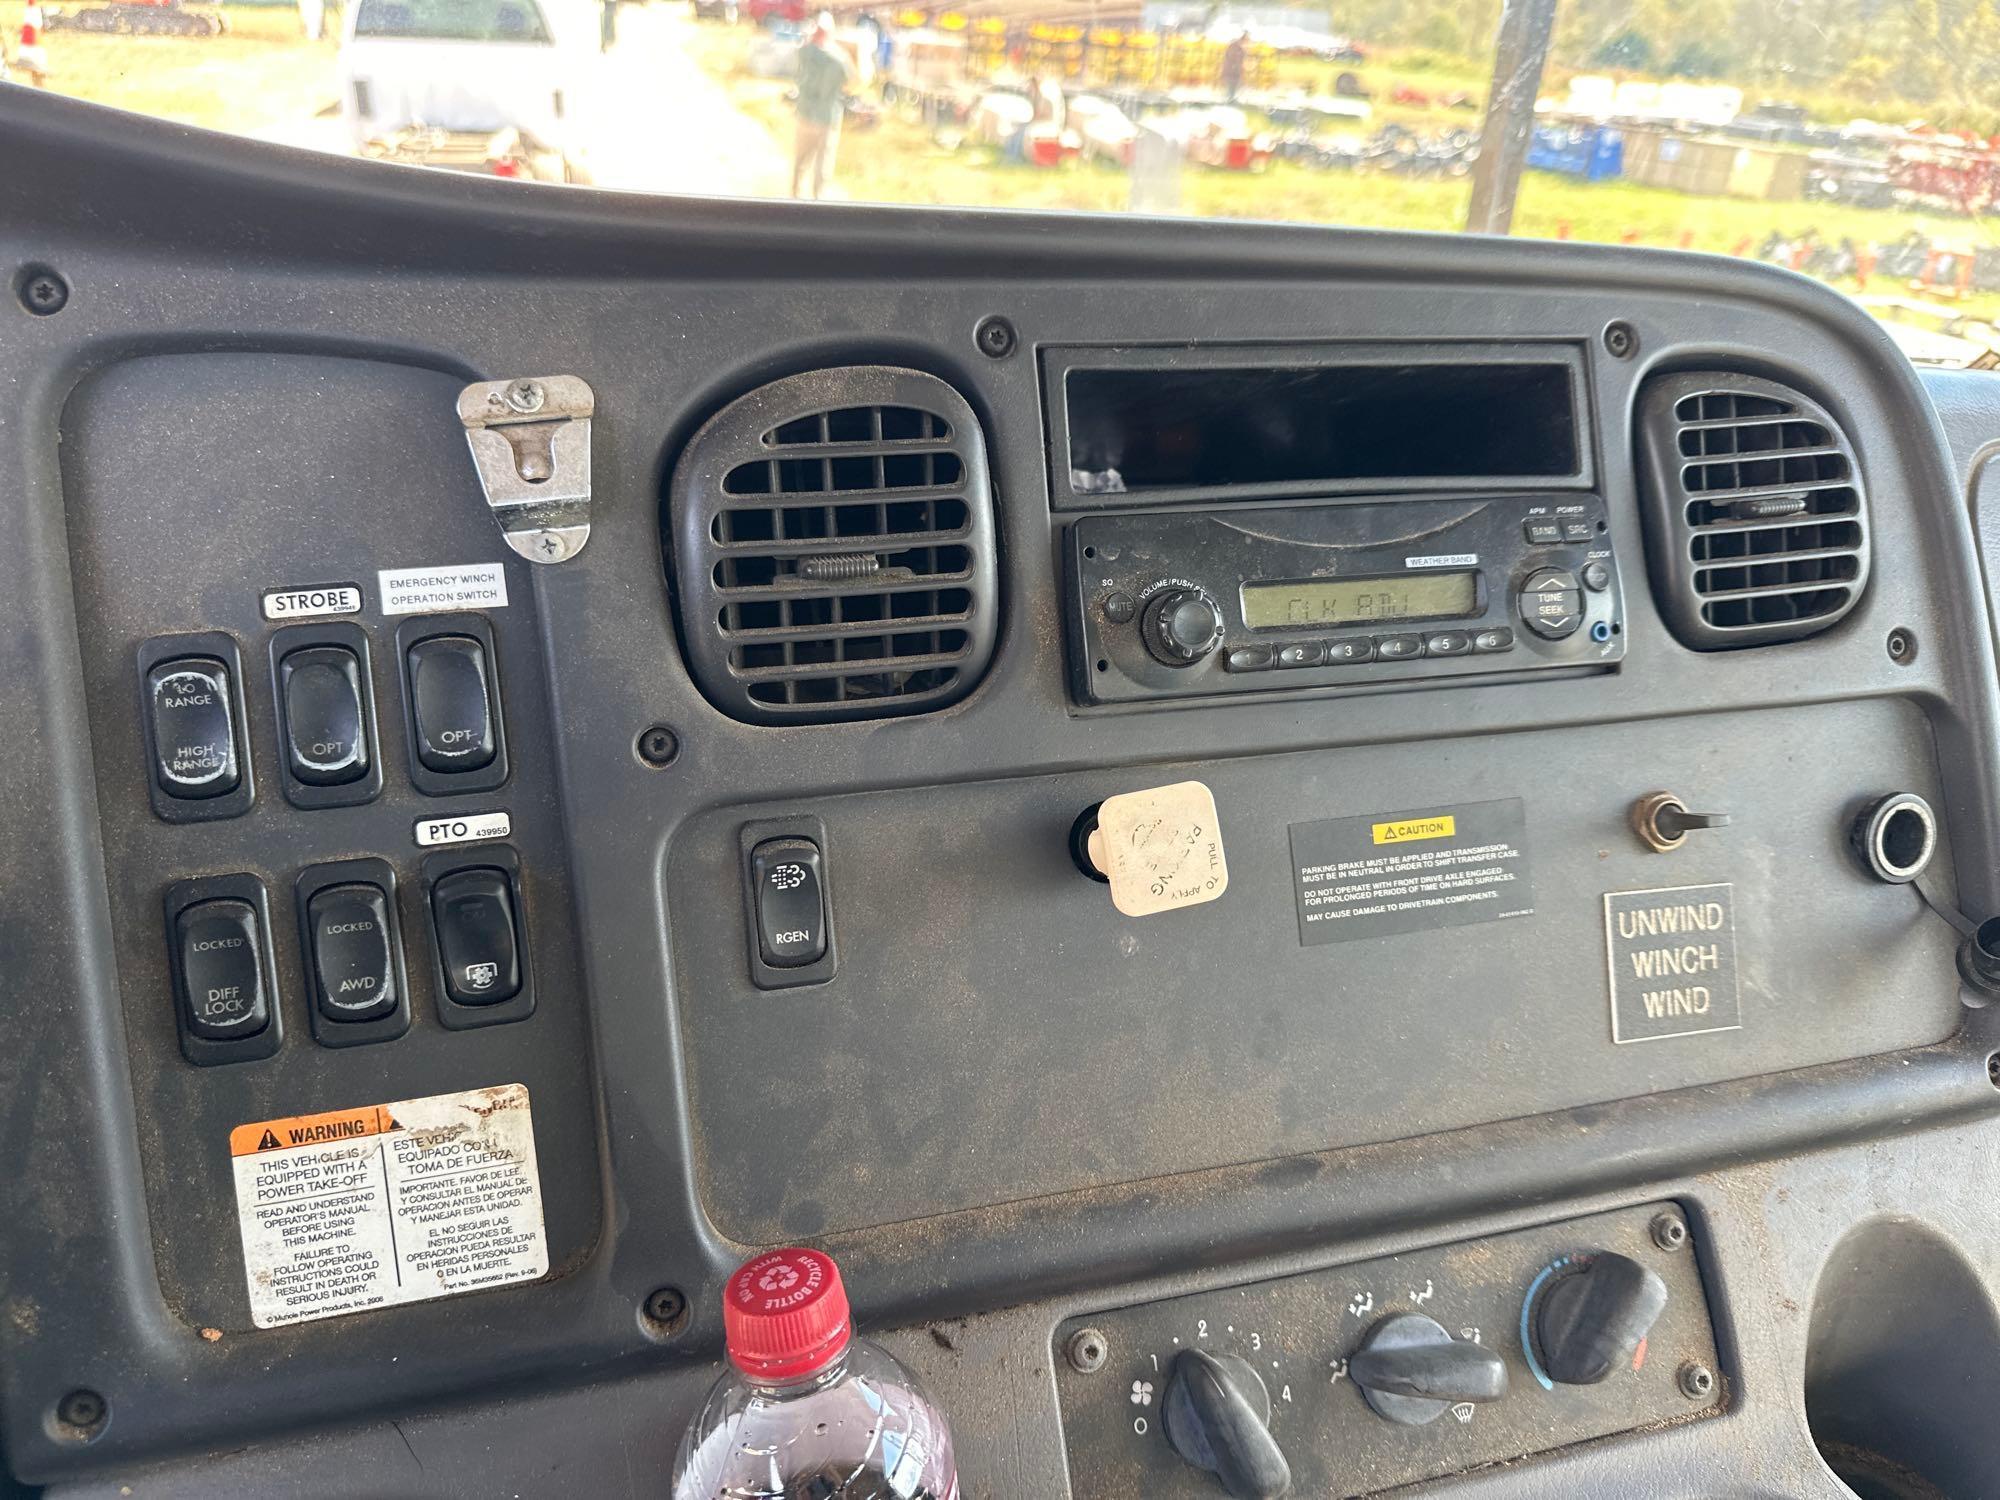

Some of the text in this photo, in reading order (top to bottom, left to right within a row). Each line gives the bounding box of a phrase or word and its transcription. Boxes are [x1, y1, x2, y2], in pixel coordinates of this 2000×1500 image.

[1532, 527, 1556, 535] BAND
[1568, 525, 1588, 534] SRC
[1410, 555, 1473, 566] WEATHER BAND
[390, 574, 495, 589] EMERGENCY WINCH
[275, 591, 349, 612] STROBE
[391, 589, 497, 605] OPERATION SWITCH
[1109, 601, 1133, 611] MUTE
[1538, 593, 1563, 603] TUNE
[1539, 605, 1565, 615] SEEK
[1442, 638, 1449, 649] 5
[1489, 636, 1496, 646] 6
[1296, 650, 1303, 660] 2
[1345, 646, 1352, 657] 3
[165, 695, 212, 708] RANGE
[441, 729, 473, 743] OPT
[178, 745, 214, 757] HIGH
[312, 741, 343, 756] OPT
[173, 758, 219, 770] RANGE
[429, 822, 508, 840] PTO 439950
[1398, 822, 1444, 836] CAUTION
[1302, 865, 1336, 875] PARKING
[1338, 861, 1365, 870] BRAKE
[1367, 858, 1387, 867] MUST
[1402, 852, 1434, 862] APPLIED
[1453, 844, 1508, 856] TRANSMISSION
[1303, 874, 1324, 883] MUST
[1326, 872, 1337, 880] BE
[1348, 867, 1384, 877] NEUTRAL
[1395, 861, 1422, 871] ORDER
[1435, 857, 1456, 866] SHIFT
[1458, 853, 1497, 863] TRANSFER
[1305, 898, 1321, 906] FOR
[1323, 892, 1371, 903] PROLONGED
[1374, 887, 1407, 897] PERIODS
[1420, 883, 1438, 891] TIME
[1452, 878, 1473, 887] HARD
[1318, 888, 1333, 896] NOT
[1335, 884, 1371, 894] OPERATE
[1373, 881, 1391, 889] WITH
[1394, 877, 1419, 887] FRONT
[1421, 875, 1443, 884] DRIVE
[1445, 872, 1465, 880] AXLE
[1325, 910, 1351, 919] CAUSE
[1353, 905, 1385, 915] DAMAGE
[1399, 898, 1445, 910] DRIVETRAIN
[1446, 890, 1498, 903] COMPONENTS.
[327, 921, 373, 935] LOCKED
[1619, 903, 1724, 939] UNWIND
[193, 938, 244, 952] LOCKED
[776, 930, 809, 945] RGEN
[1631, 944, 1719, 979] WINCH
[339, 976, 375, 992] AWD
[208, 986, 240, 1002] DIFF
[1642, 986, 1711, 1019] WIND
[205, 999, 244, 1016] LOCK
[289, 1120, 365, 1144] WARNING
[394, 1137, 424, 1151] ESTE
[260, 1148, 359, 1173] THIS VEHICLE IS
[398, 1145, 460, 1163] EQUIPADO
[408, 1150, 513, 1175] TOMA DE FUERZA
[257, 1160, 367, 1187] EQUIPPED WITH A
[460, 1169, 502, 1185] FAVOR DE
[258, 1173, 367, 1200] POWER TAKE-OFF
[400, 1196, 407, 1205] Y
[410, 1189, 462, 1204] CONSULTAR
[464, 1186, 475, 1195] EL
[477, 1179, 514, 1192] MANUAL
[452, 1196, 480, 1207] ANTES
[483, 1192, 495, 1201] DE
[497, 1186, 533, 1199] OPERAR
[257, 1193, 375, 1219] READ AND UNDERSTAND
[410, 1199, 522, 1225] Y MANEJAR ESTA UNIDAD.
[264, 1204, 370, 1229] OPERATOR'S MANUAL
[282, 1217, 355, 1236] BEFORE USING
[430, 1216, 509, 1237] EL NO SEGUIR LAS
[284, 1228, 356, 1247] THIS MACHINE.
[428, 1226, 513, 1248] INSTRUCCIONES DE
[461, 1241, 490, 1253] PUEDA
[493, 1232, 536, 1246] RESULTAR
[294, 1244, 350, 1262] FAILURE TO
[417, 1244, 529, 1271] EN HERIDAS PERSONALES
[274, 1251, 373, 1276] FOLLOW OPERATING
[446, 1266, 458, 1277] EN
[460, 1264, 471, 1274] LA
[474, 1258, 512, 1272] MUERTE.
[270, 1261, 379, 1287] INSTRUCTIONS COULD
[765, 1256, 822, 1309] RECYCLE BOTTLE
[276, 1272, 376, 1297] RESULT IN DEATH OR
[286, 1284, 368, 1305] SERIOUS INJURY.
[1198, 1320, 1208, 1338] 2
[1251, 1333, 1261, 1350] 3
[1151, 1354, 1159, 1371] 1
[1282, 1385, 1292, 1402] 4
